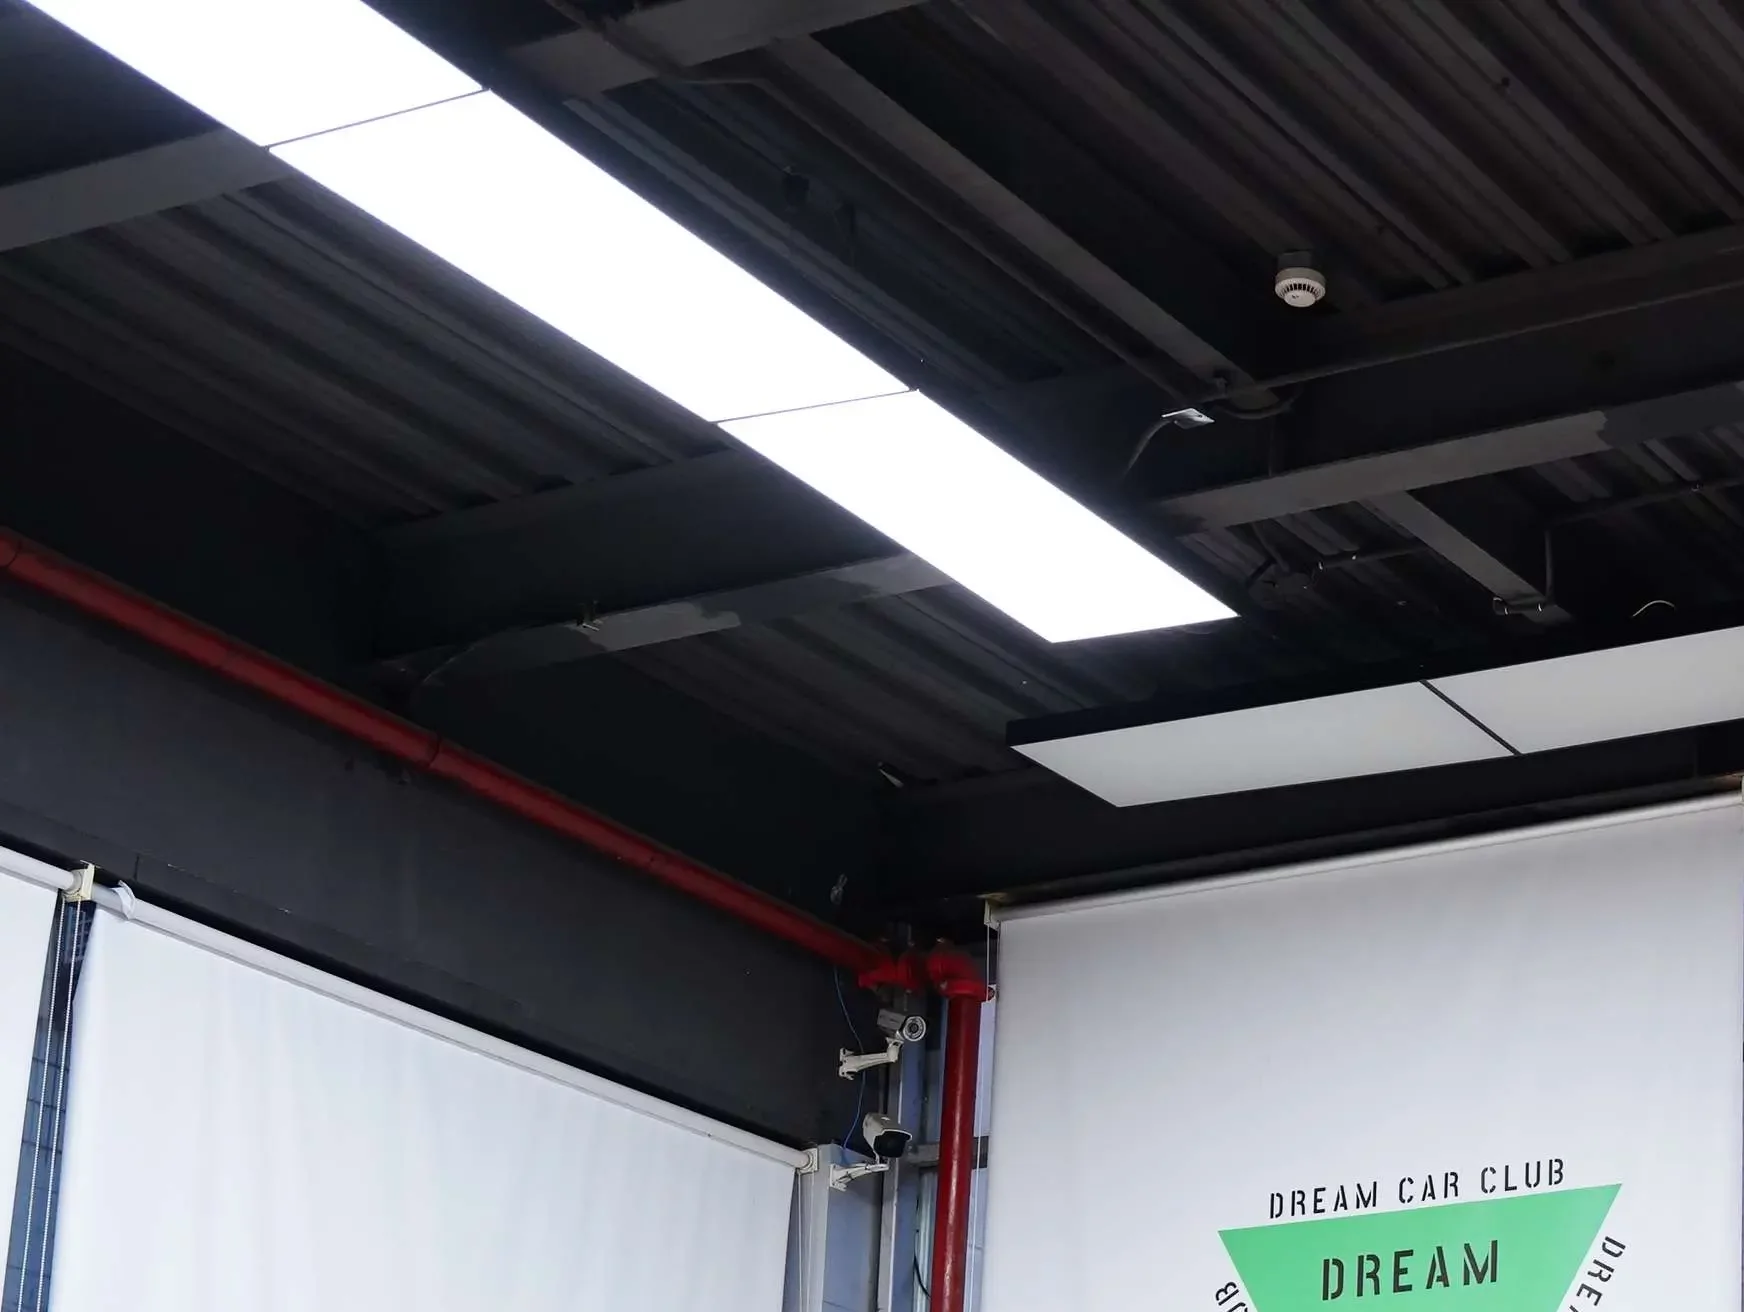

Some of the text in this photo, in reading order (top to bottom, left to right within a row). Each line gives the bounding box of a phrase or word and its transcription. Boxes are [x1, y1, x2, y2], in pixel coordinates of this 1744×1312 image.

[1269, 1158, 1565, 1219] DREAM CAR CLUB
[1322, 1239, 1498, 1301] DREAM
